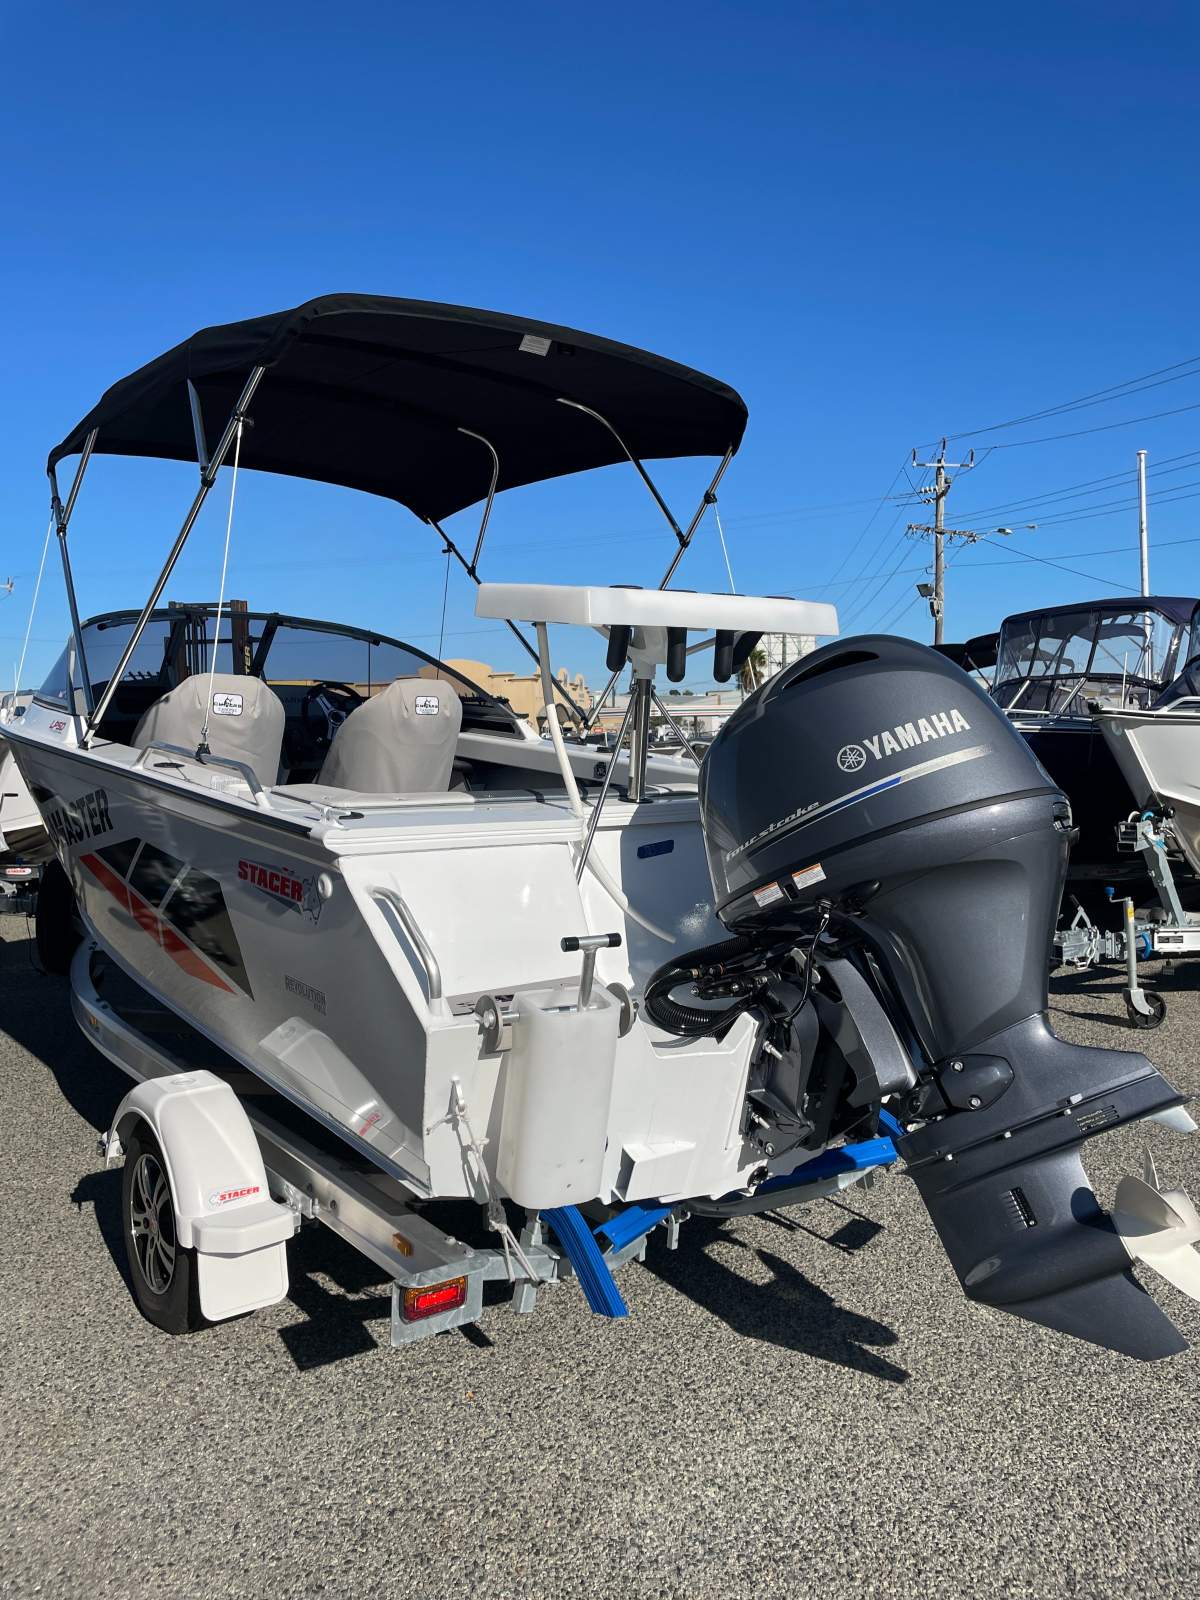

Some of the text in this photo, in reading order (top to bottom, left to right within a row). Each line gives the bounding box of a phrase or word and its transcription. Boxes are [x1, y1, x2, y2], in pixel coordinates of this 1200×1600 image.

[862, 709, 972, 760] YAMAHA
[238, 859, 304, 903] STACER
[219, 1186, 260, 1201] STACER
